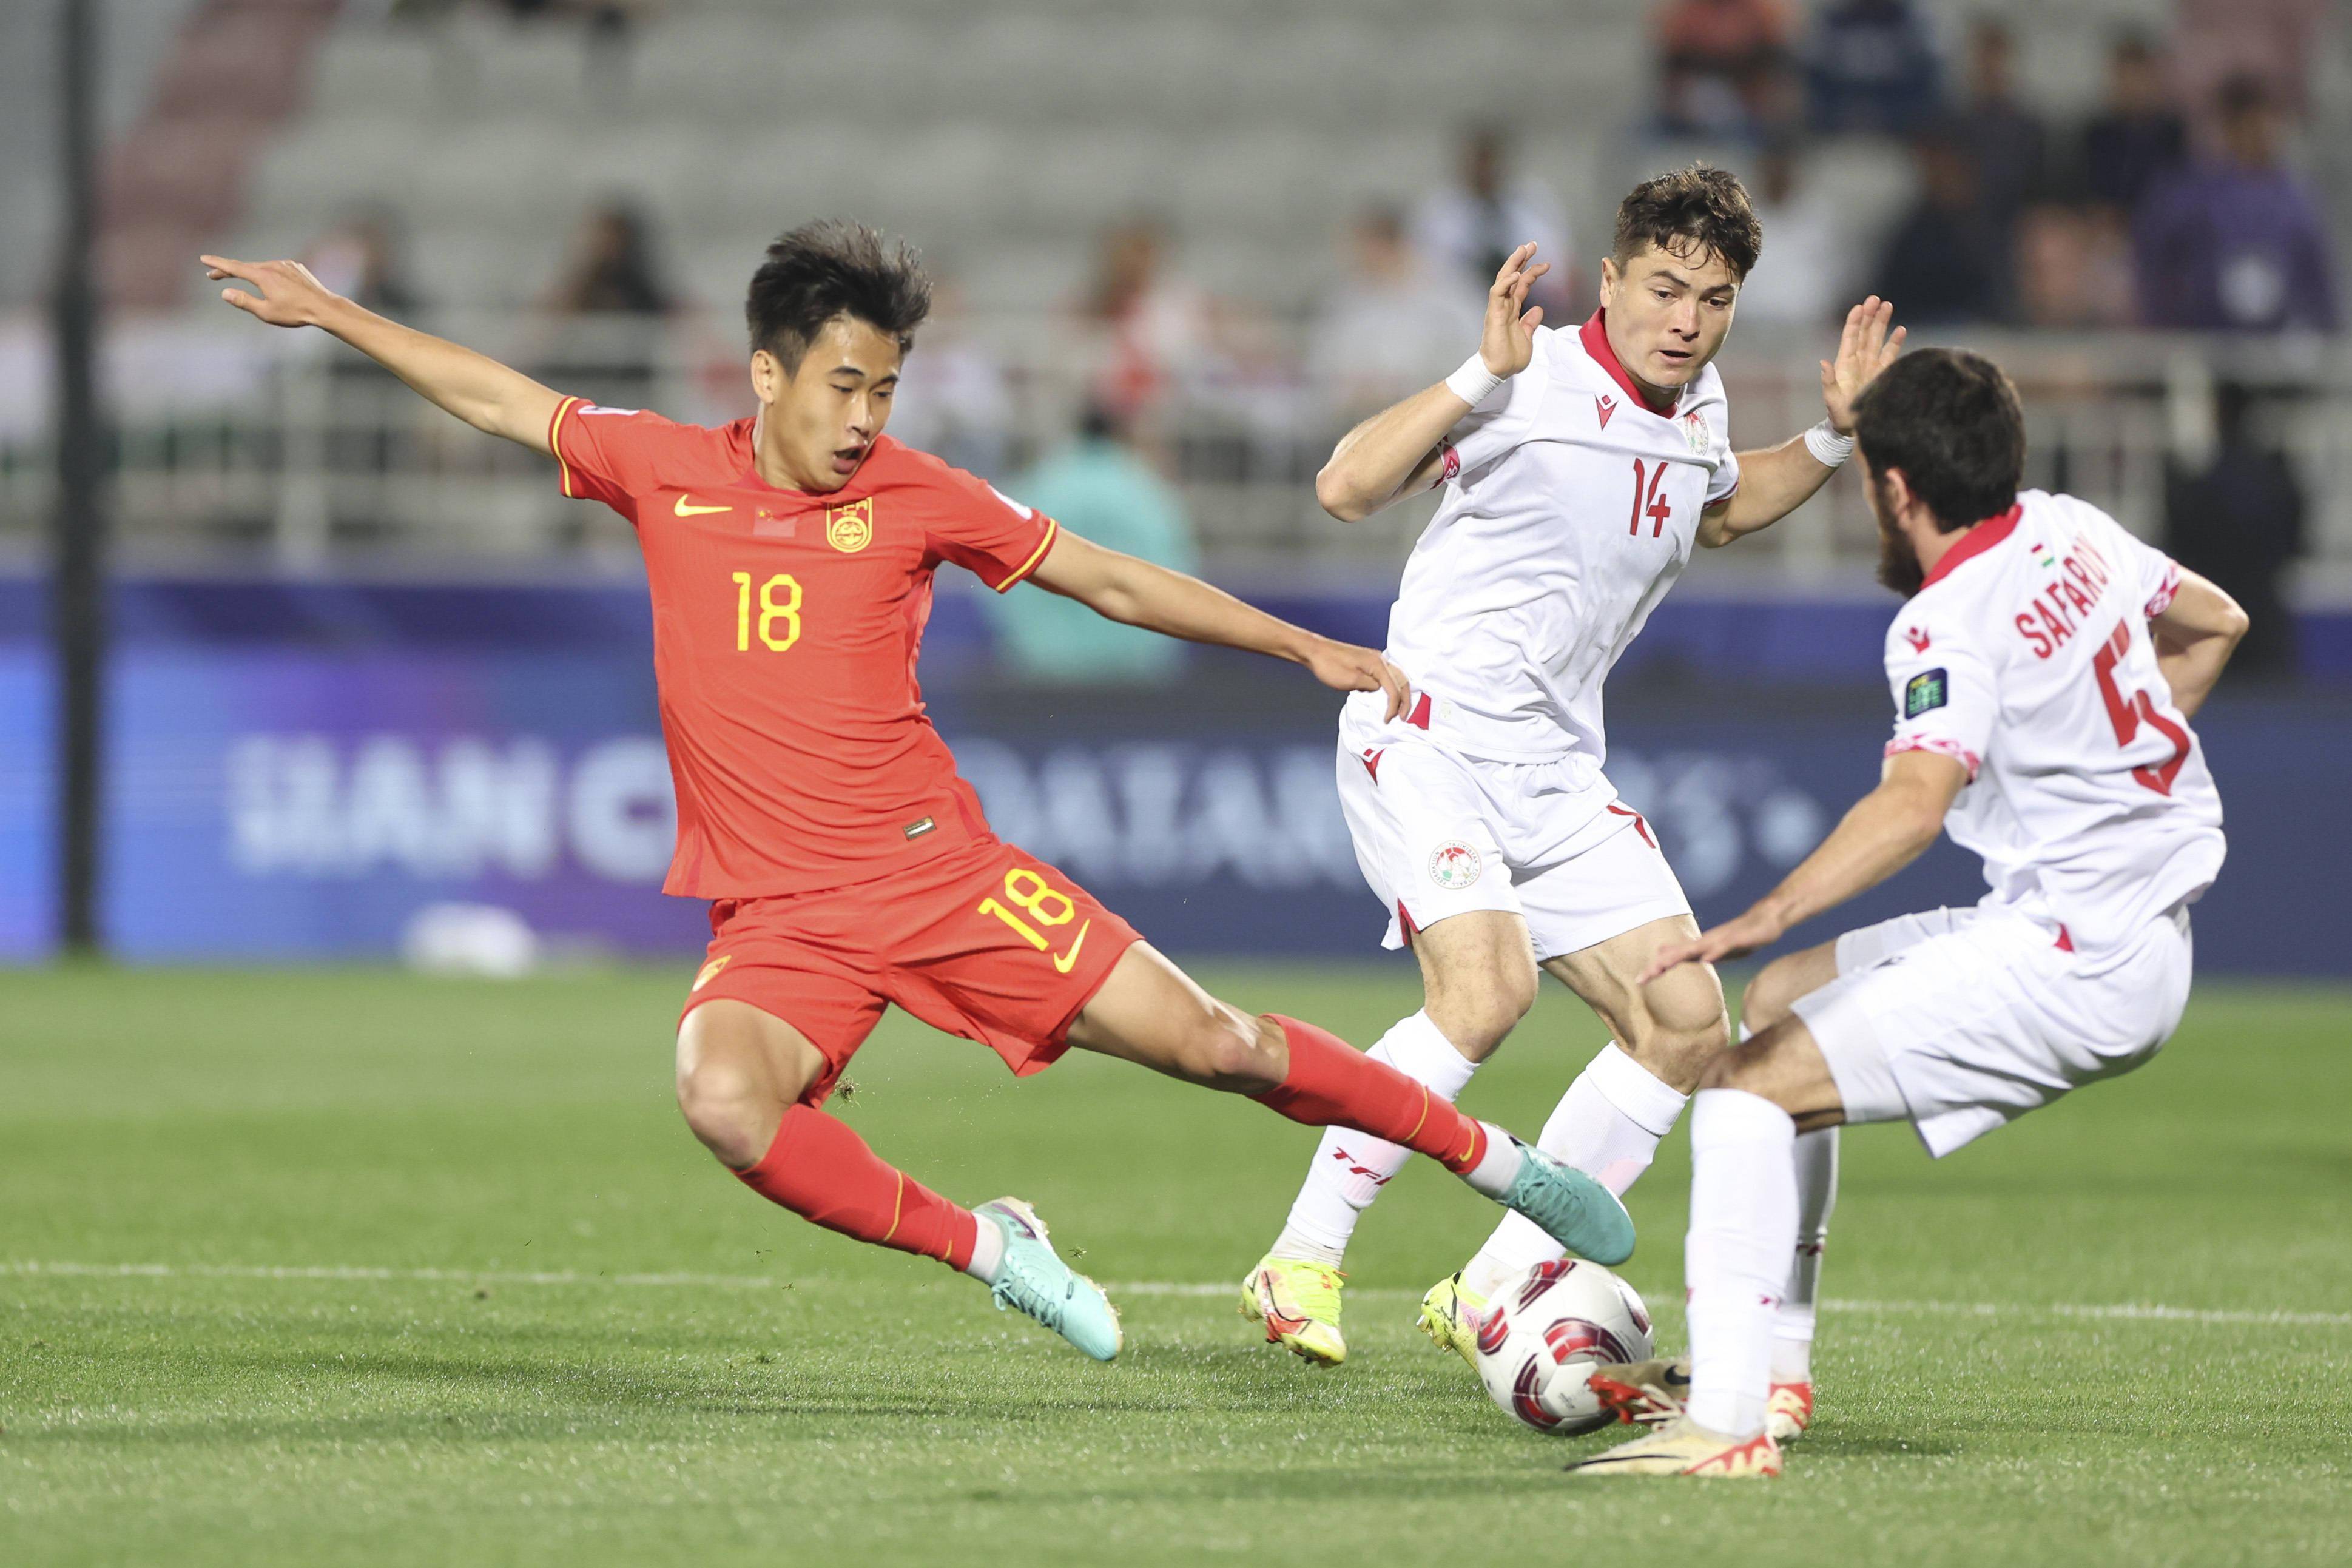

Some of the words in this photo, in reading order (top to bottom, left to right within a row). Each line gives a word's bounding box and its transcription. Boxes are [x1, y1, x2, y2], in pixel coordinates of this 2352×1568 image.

[1629, 457, 1671, 538] 14
[732, 571, 803, 652] 18
[2092, 617, 2191, 796] 5
[1448, 842, 1478, 864] TAJIKISTAN
[1451, 868, 1479, 887] FOOTBALL
[977, 867, 1076, 952] 18
